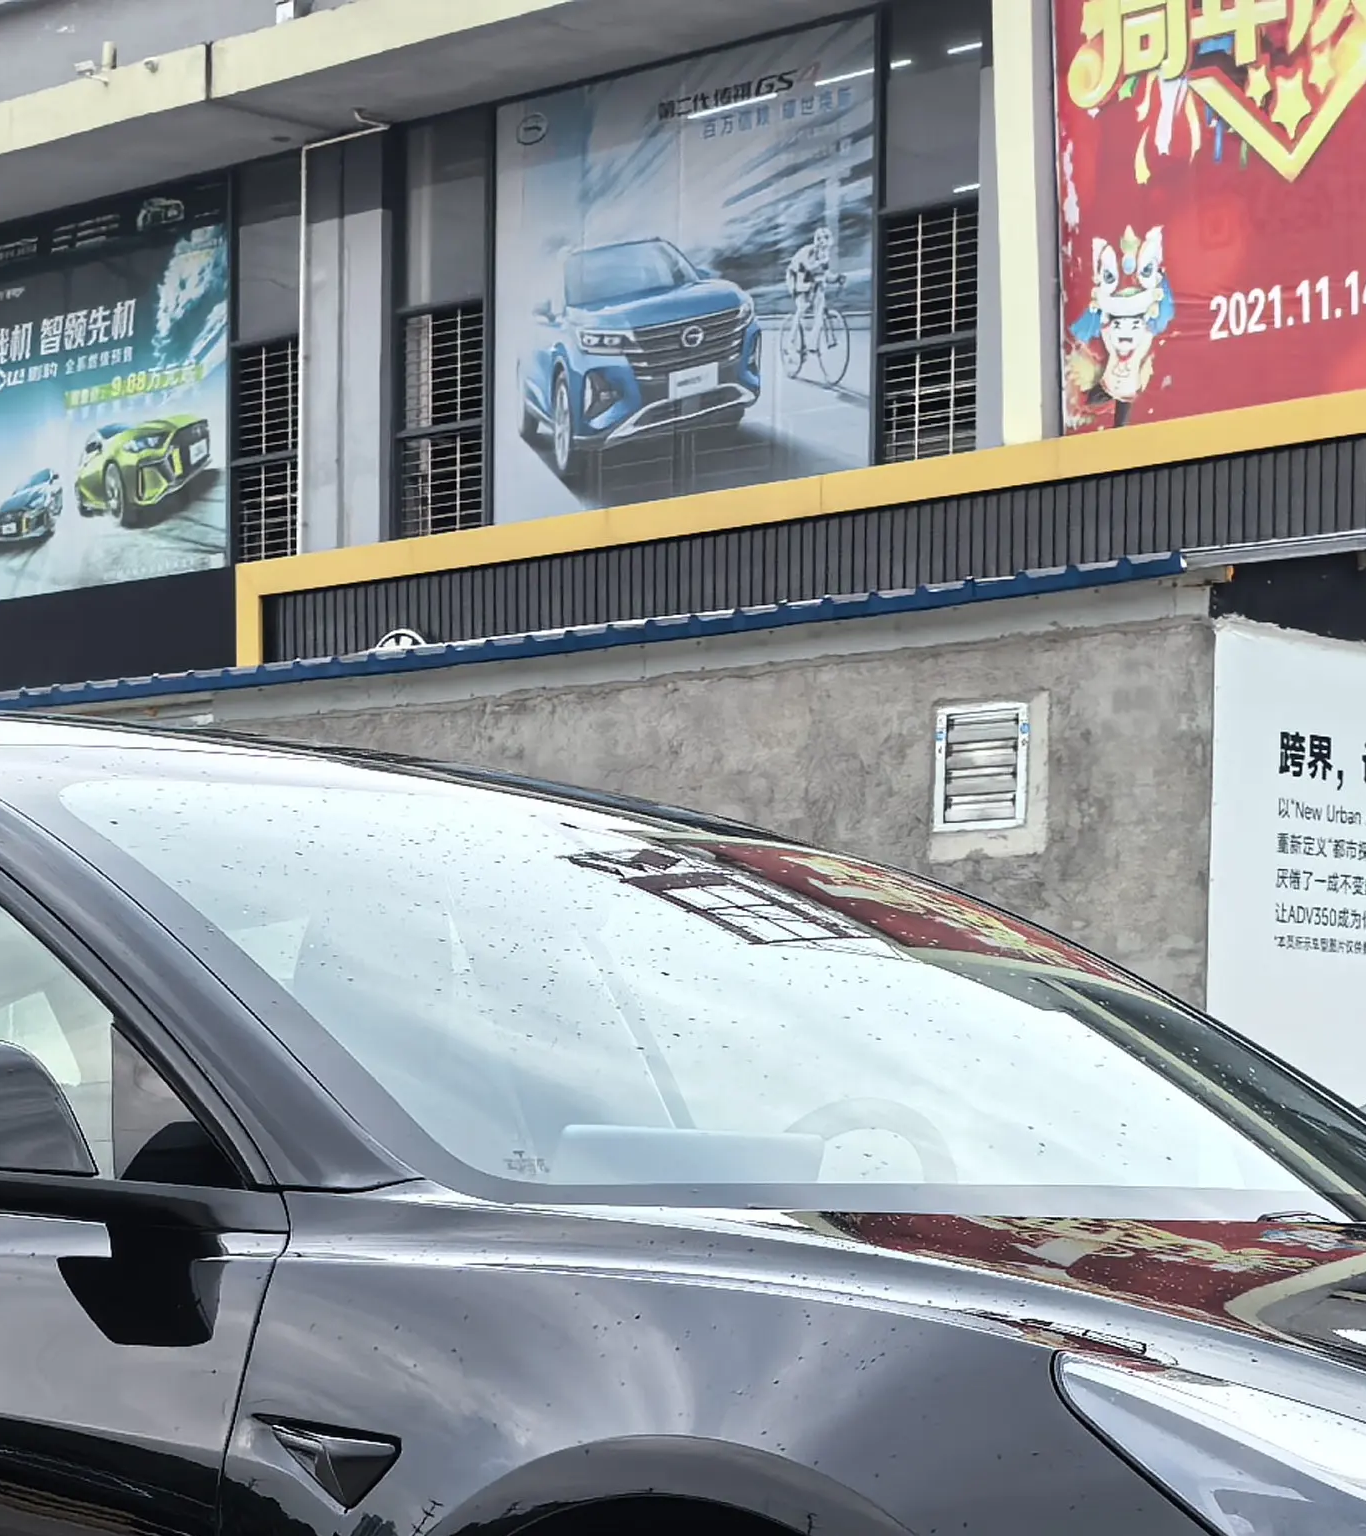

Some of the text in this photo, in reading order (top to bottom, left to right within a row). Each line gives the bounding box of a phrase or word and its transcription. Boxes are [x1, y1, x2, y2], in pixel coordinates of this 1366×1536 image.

[40, 299, 137, 356] 智领先机
[1325, 804, 1362, 826] Urban
